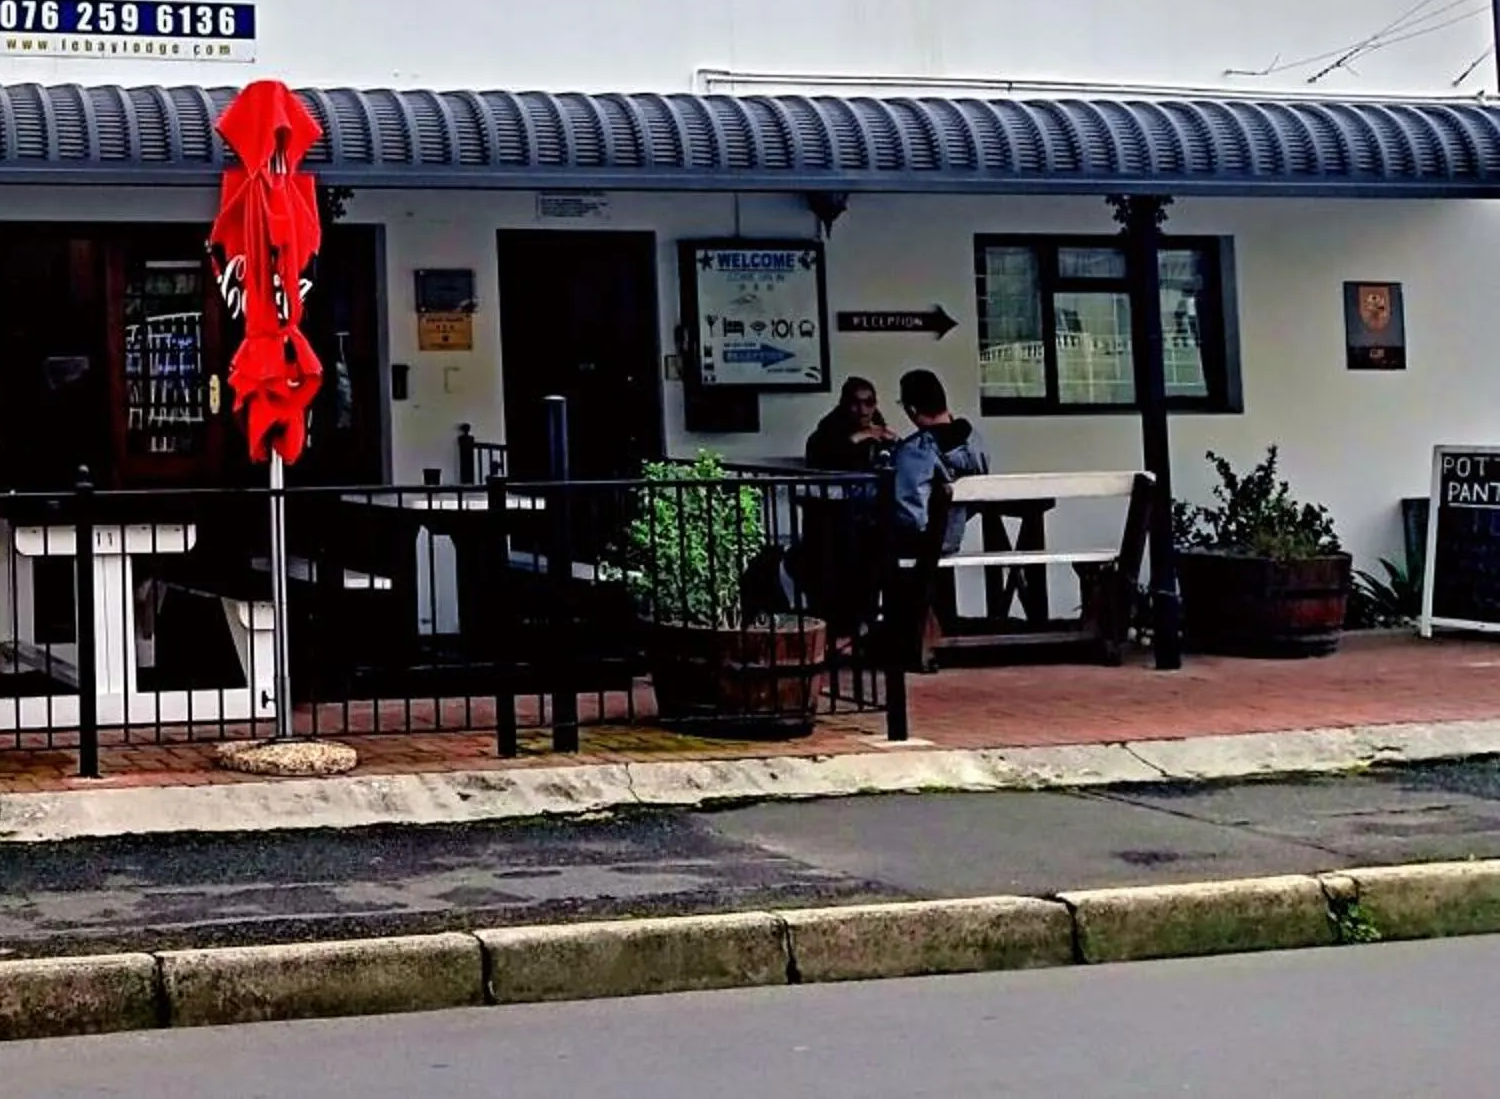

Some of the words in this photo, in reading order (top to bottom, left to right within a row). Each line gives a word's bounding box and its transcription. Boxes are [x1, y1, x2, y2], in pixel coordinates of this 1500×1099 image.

[0, 0, 60, 31] 076
[76, 2, 140, 33] 259
[156, 4, 236, 35] 6136
[6, 38, 232, 55] www.lebaylodge.com
[717, 252, 796, 268] WELCOME
[851, 316, 925, 329] RECEPTION
